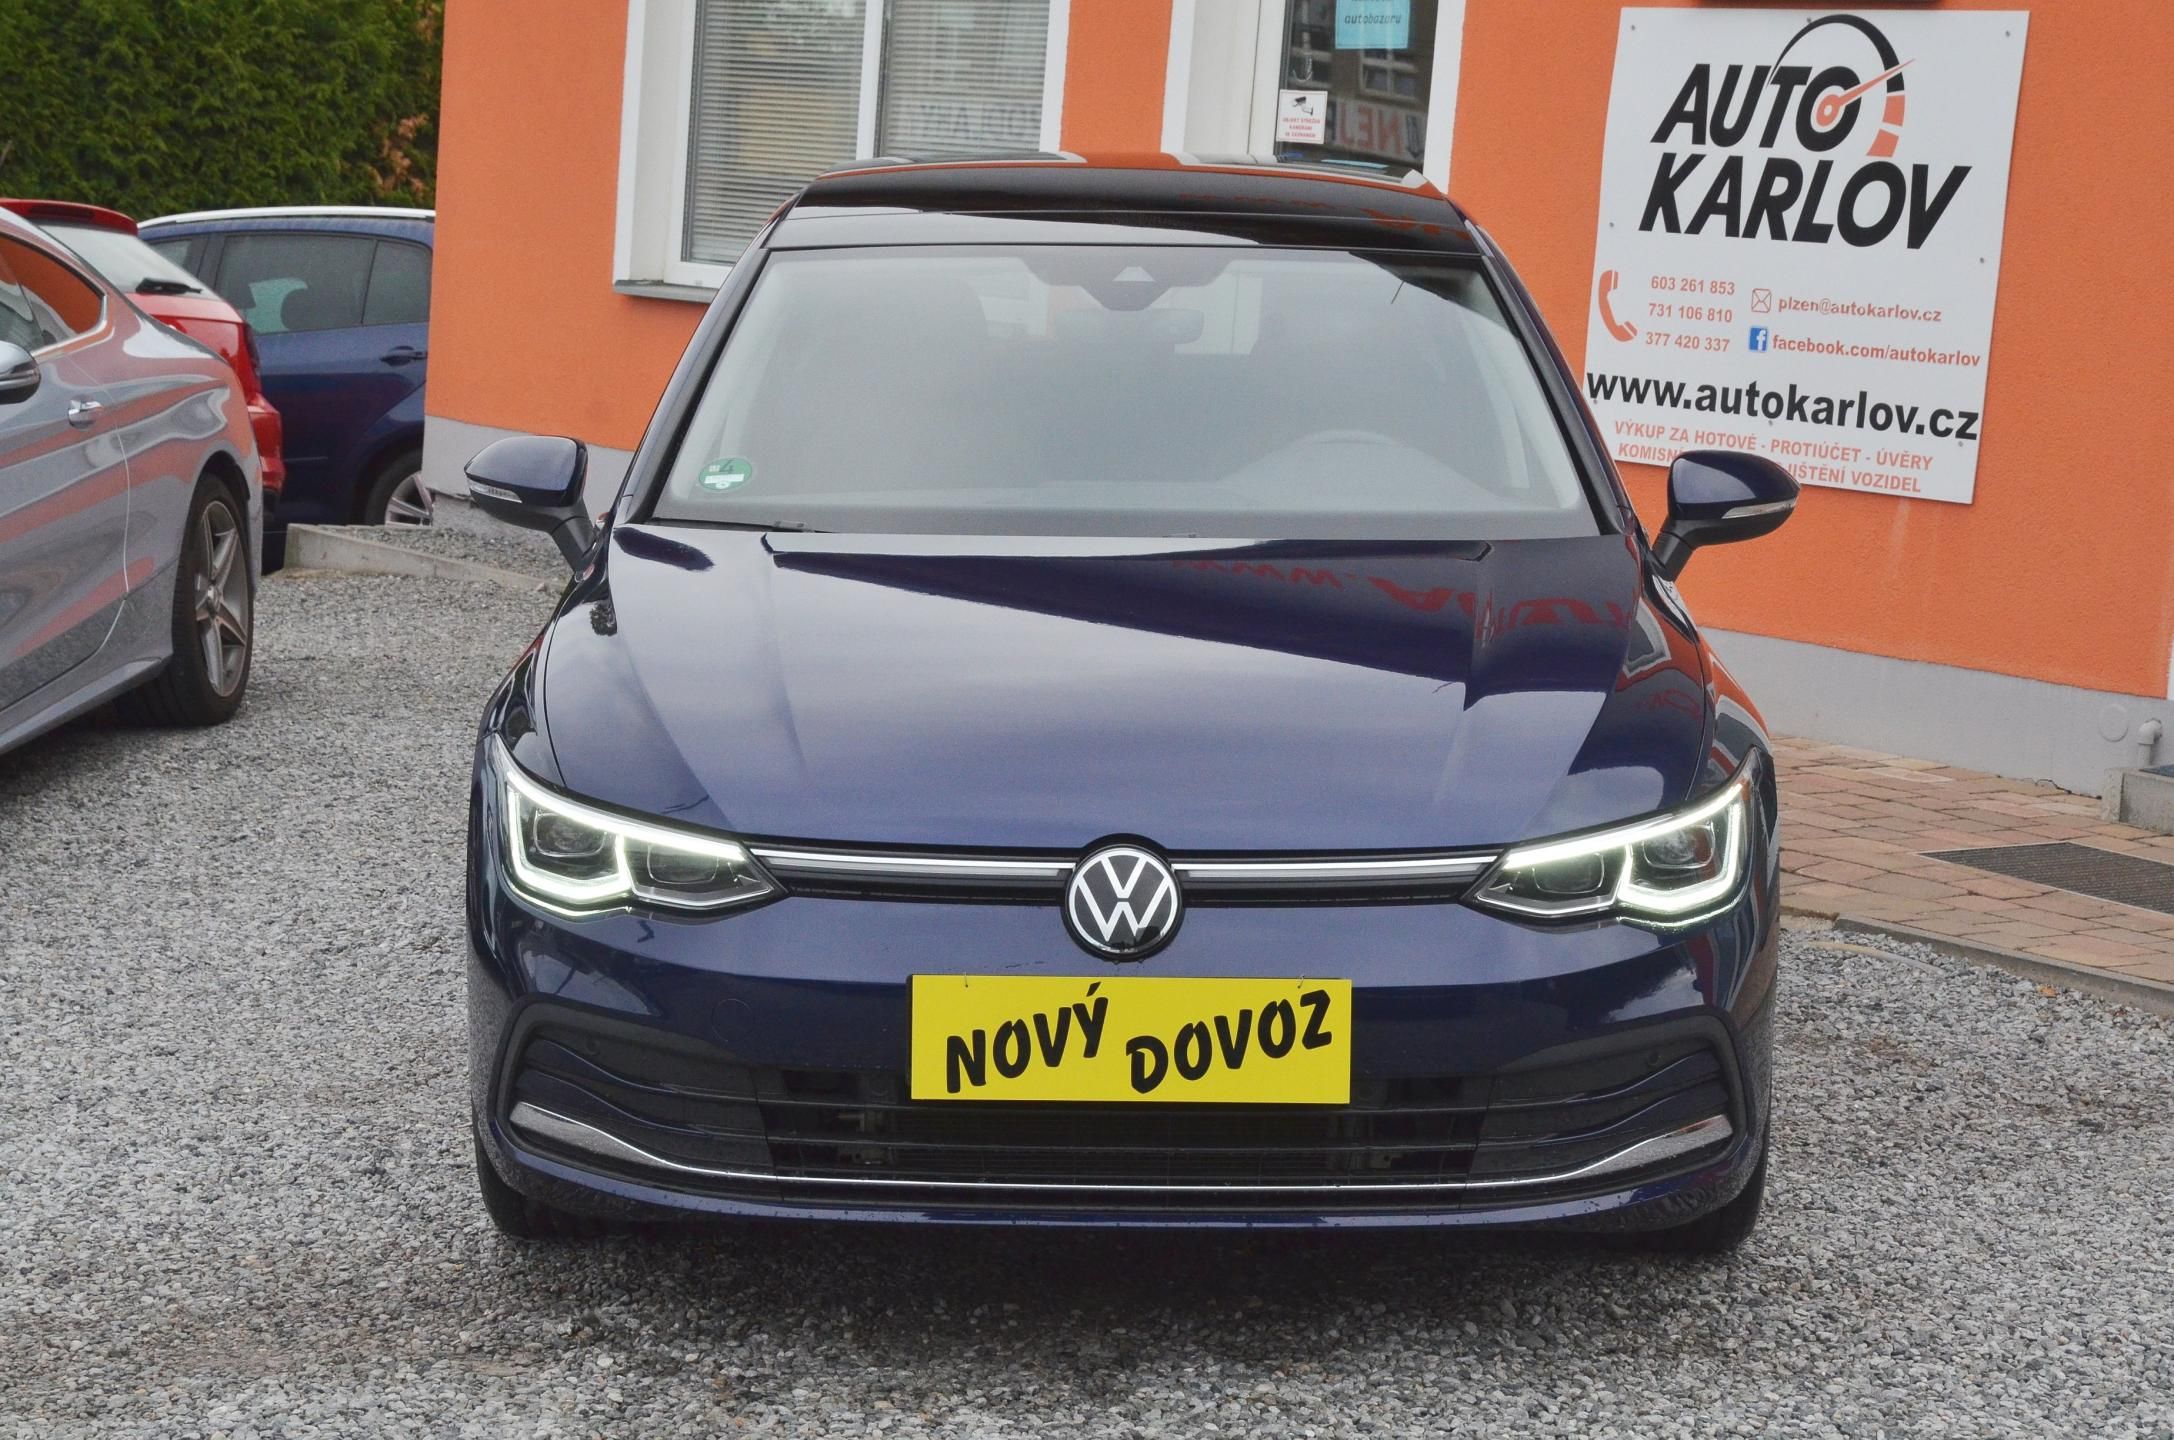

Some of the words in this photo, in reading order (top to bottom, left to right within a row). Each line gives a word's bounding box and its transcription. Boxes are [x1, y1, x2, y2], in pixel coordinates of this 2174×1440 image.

[1650, 63, 1862, 152] AUTO
[1638, 152, 1973, 249] KARLOV
[1651, 275, 1676, 291] 603
[1680, 277, 1704, 293] 261
[1710, 280, 1736, 296] 853
[1649, 302, 1672, 318] 731
[1678, 305, 1703, 320] 106
[1707, 308, 1733, 323] 810
[1778, 296, 1942, 322] plzen@autokarlov.cz
[1645, 331, 1671, 346] 377
[1674, 334, 1700, 350] 420
[1704, 337, 1730, 352] 337
[1773, 334, 1981, 366] facebook.com/autokarlov
[1587, 372, 1979, 440] www.autokarlov.cz
[1615, 418, 1665, 440] VÝKUP
[1669, 427, 1689, 443] ZA
[1694, 431, 1758, 450] HOTOVÉ
[1770, 438, 1862, 463] PROTIÚČET
[1876, 448, 1934, 471] ÚVĚRY
[1851, 470, 1921, 493] VOZIDEL
[946, 981, 1109, 1094] NOVÝ
[1125, 989, 1333, 1095] DOVOZ
